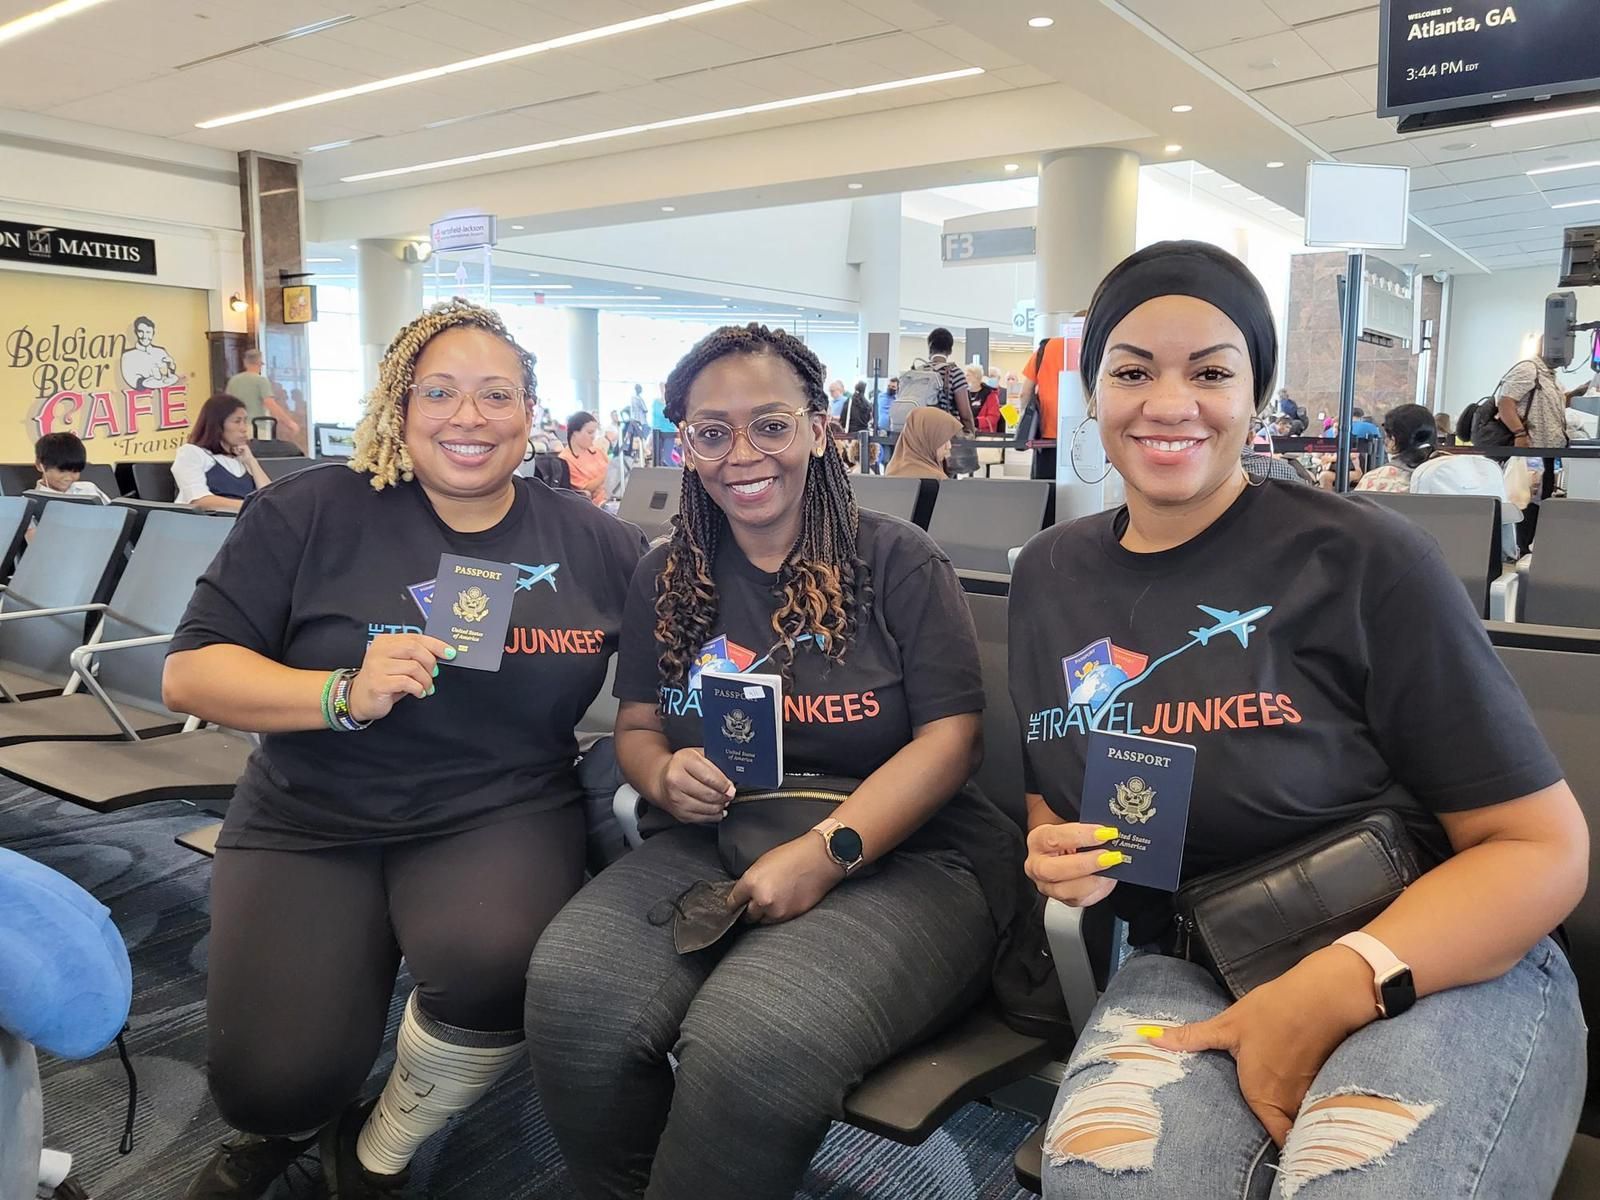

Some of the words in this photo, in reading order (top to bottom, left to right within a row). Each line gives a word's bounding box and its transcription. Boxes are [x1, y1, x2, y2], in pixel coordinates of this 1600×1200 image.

[1407, 16, 1480, 41] Atlanta,
[1485, 6, 1517, 27] GA
[1408, 9, 1441, 20] WELCOME
[1406, 65, 1437, 81] 3:44
[1440, 60, 1463, 75] PM
[1465, 63, 1479, 72] EDT
[58, 238, 141, 262] MATHIS
[946, 234, 975, 260] F3
[6, 325, 126, 367] Belgian
[33, 363, 110, 399] Beer
[114, 433, 185, 455] Transi
[455, 566, 503, 580] PASSPORT
[451, 627, 469, 635] United
[459, 634, 480, 642] America
[504, 627, 605, 654] JUNKEES
[784, 691, 880, 723] NKEES
[1026, 711, 1041, 744] THE
[1040, 702, 1141, 741] TRAVEL
[1141, 692, 1302, 735] JUNKEES
[733, 755, 753, 763] America
[1107, 747, 1171, 768] PASSPORT
[1119, 840, 1147, 851] America
[1132, 834, 1151, 845] States
